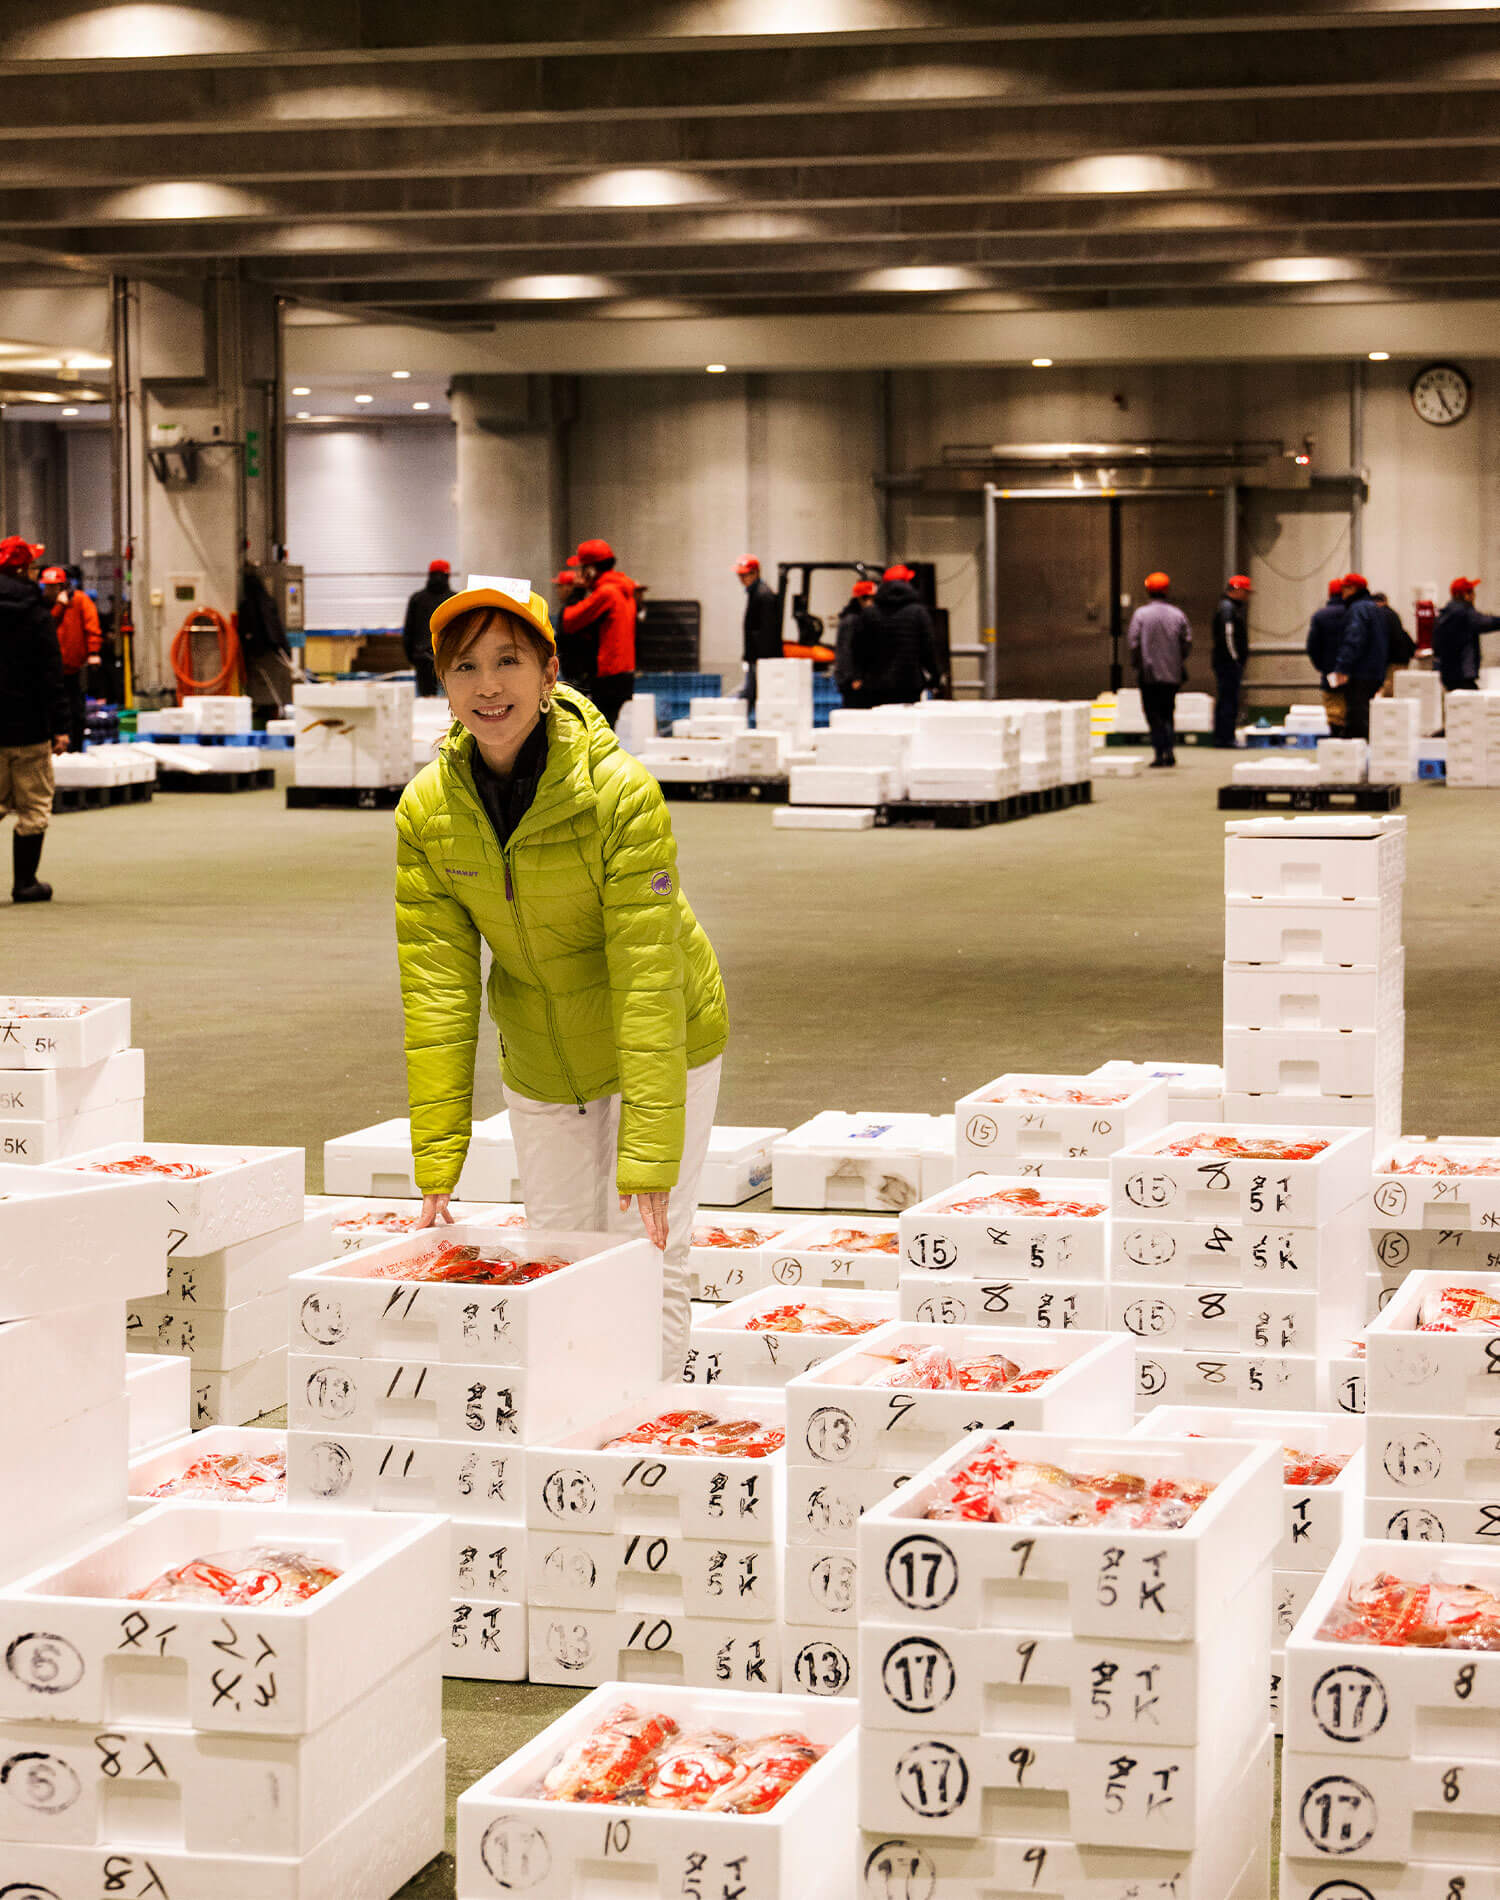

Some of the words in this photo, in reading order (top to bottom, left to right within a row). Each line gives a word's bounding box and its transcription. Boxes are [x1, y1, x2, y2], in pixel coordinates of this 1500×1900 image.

[1092, 1120, 1111, 1134] 10
[4, 1138, 27, 1154] 5K
[727, 1269, 744, 1284] 13
[981, 1283, 1014, 1312] 8
[1198, 1292, 1227, 1319] 8
[1196, 1361, 1227, 1383] 8
[622, 1460, 667, 1488] 10
[624, 1536, 668, 1571] 10
[1098, 1574, 1165, 1613] 5K
[451, 1623, 501, 1652] 5K
[628, 1619, 672, 1651] 10
[716, 1654, 767, 1684] 5K
[1454, 1663, 1478, 1699] 8
[1008, 1747, 1036, 1786] 9
[1441, 1767, 1464, 1803] 8
[604, 1818, 631, 1857] 10
[1023, 1847, 1047, 1888] 9
